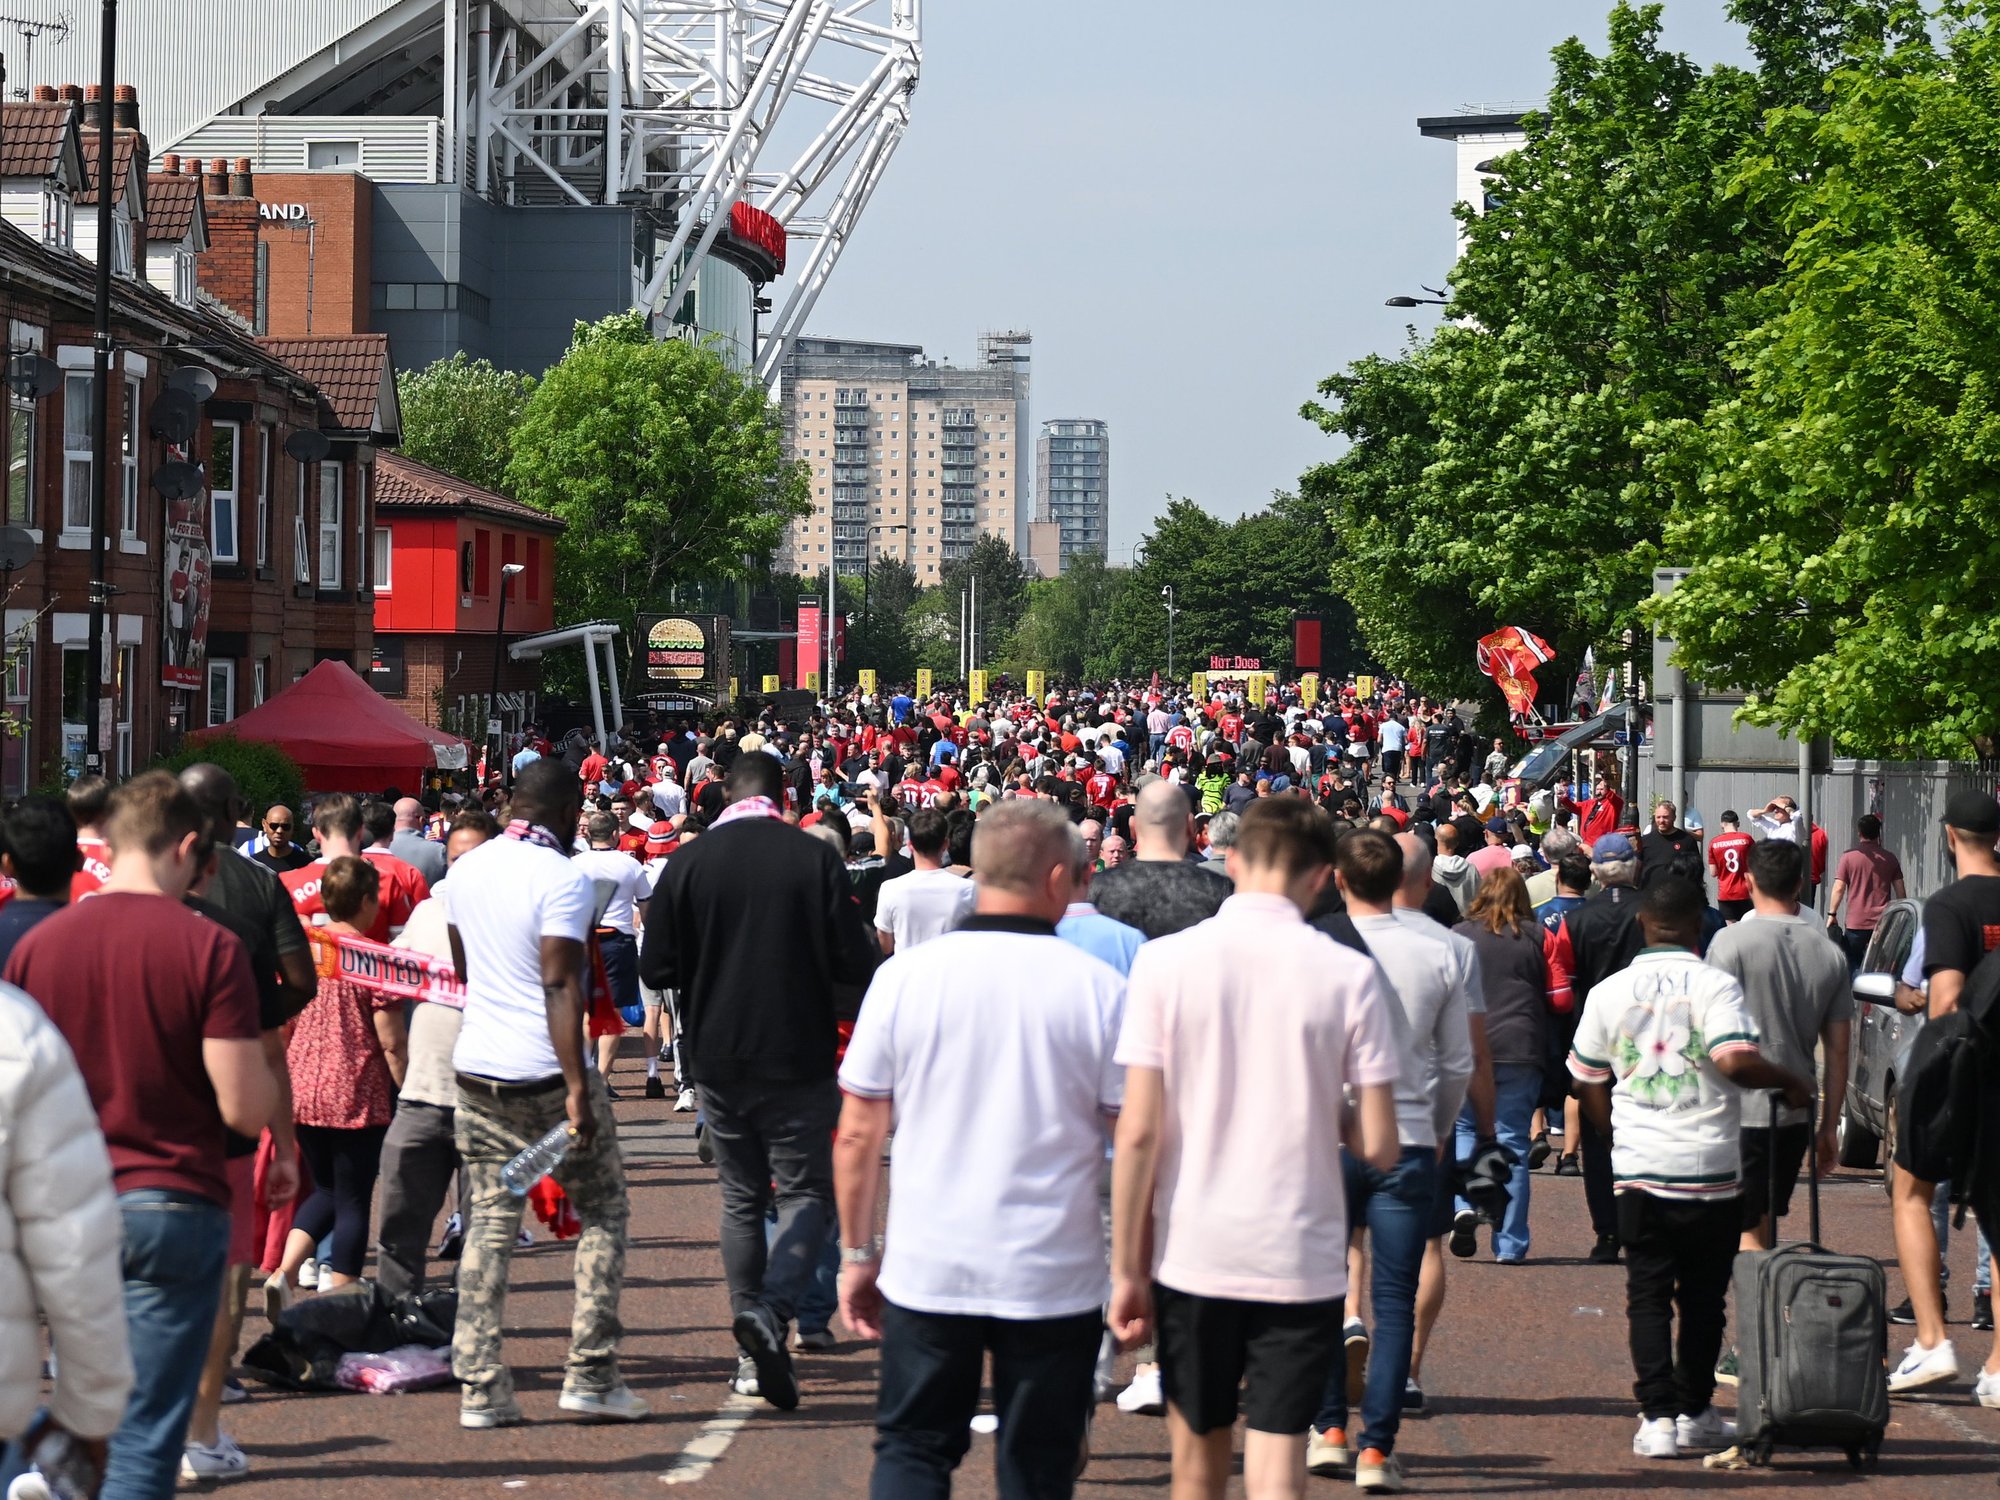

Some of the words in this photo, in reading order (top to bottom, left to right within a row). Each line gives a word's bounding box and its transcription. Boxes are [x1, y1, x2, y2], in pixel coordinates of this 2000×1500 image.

[177, 524, 190, 534] FOR
[648, 651, 705, 666] BURGER
[1175, 735, 1187, 749] 10
[1097, 781, 1107, 797] 7
[1724, 848, 1739, 873] 8
[340, 946, 421, 986] UNITED
